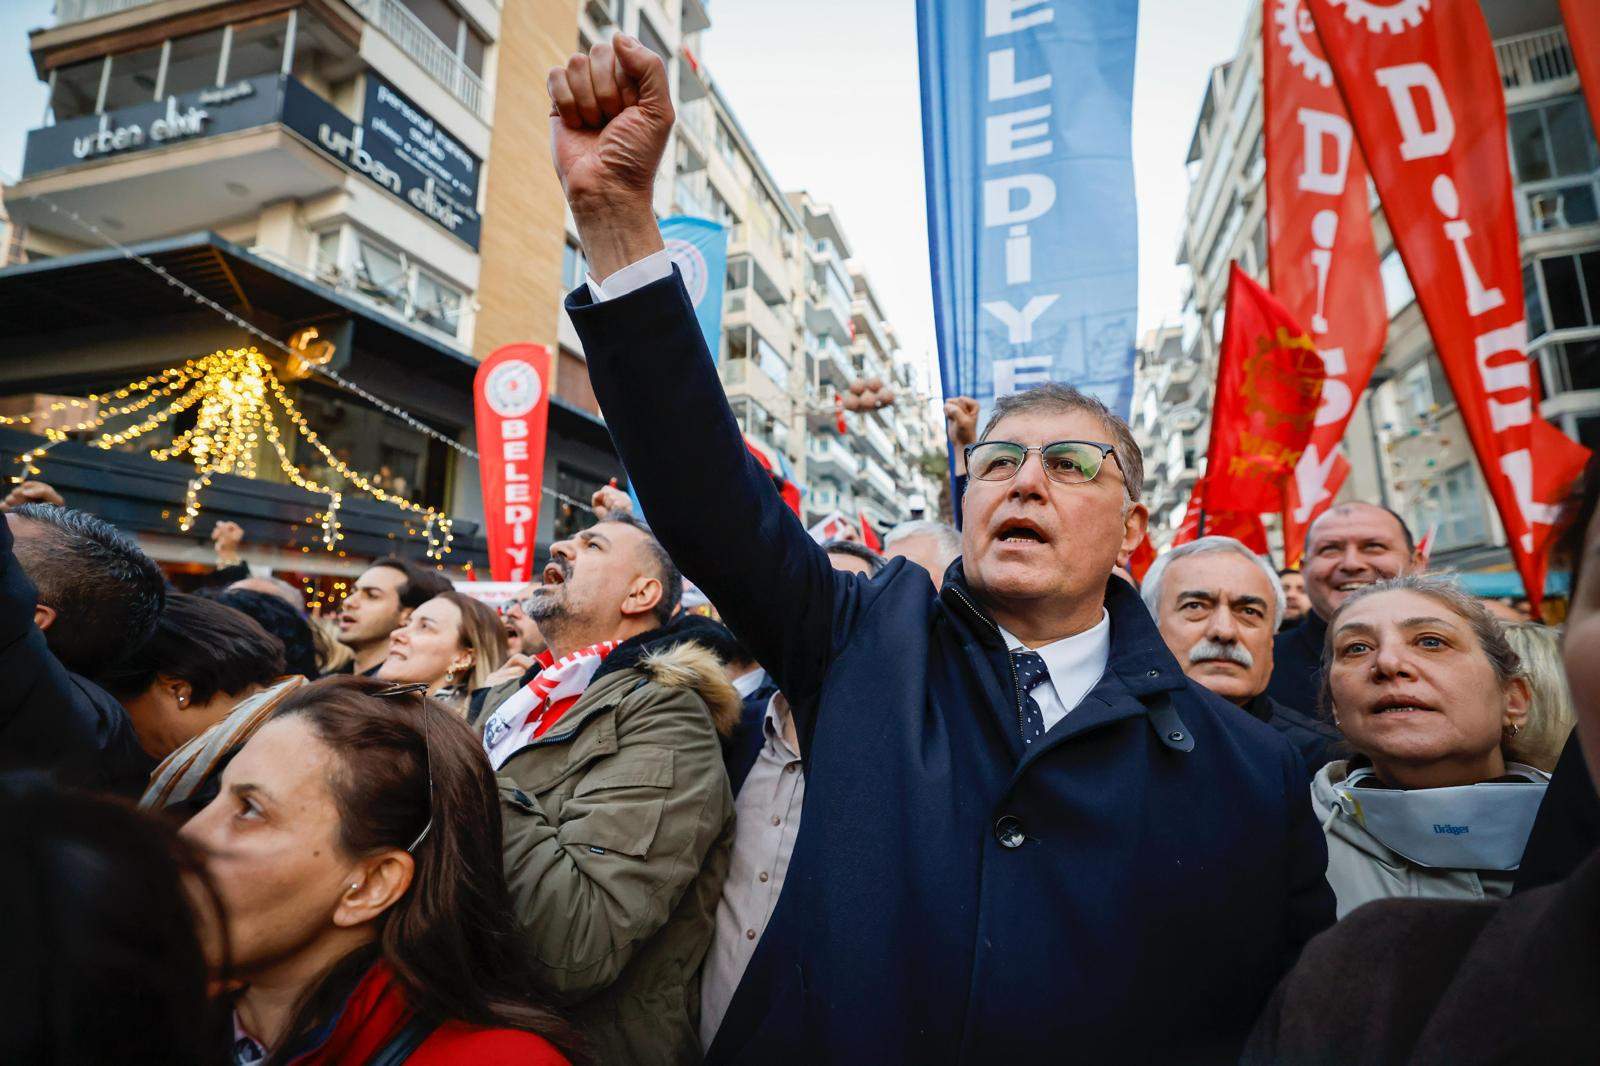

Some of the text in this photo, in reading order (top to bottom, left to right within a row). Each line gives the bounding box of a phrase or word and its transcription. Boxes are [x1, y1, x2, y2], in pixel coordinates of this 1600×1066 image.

[73, 114, 144, 158] urban
[318, 123, 402, 194] urban
[407, 177, 463, 230] elixir
[1434, 824, 1469, 835] Dräger
